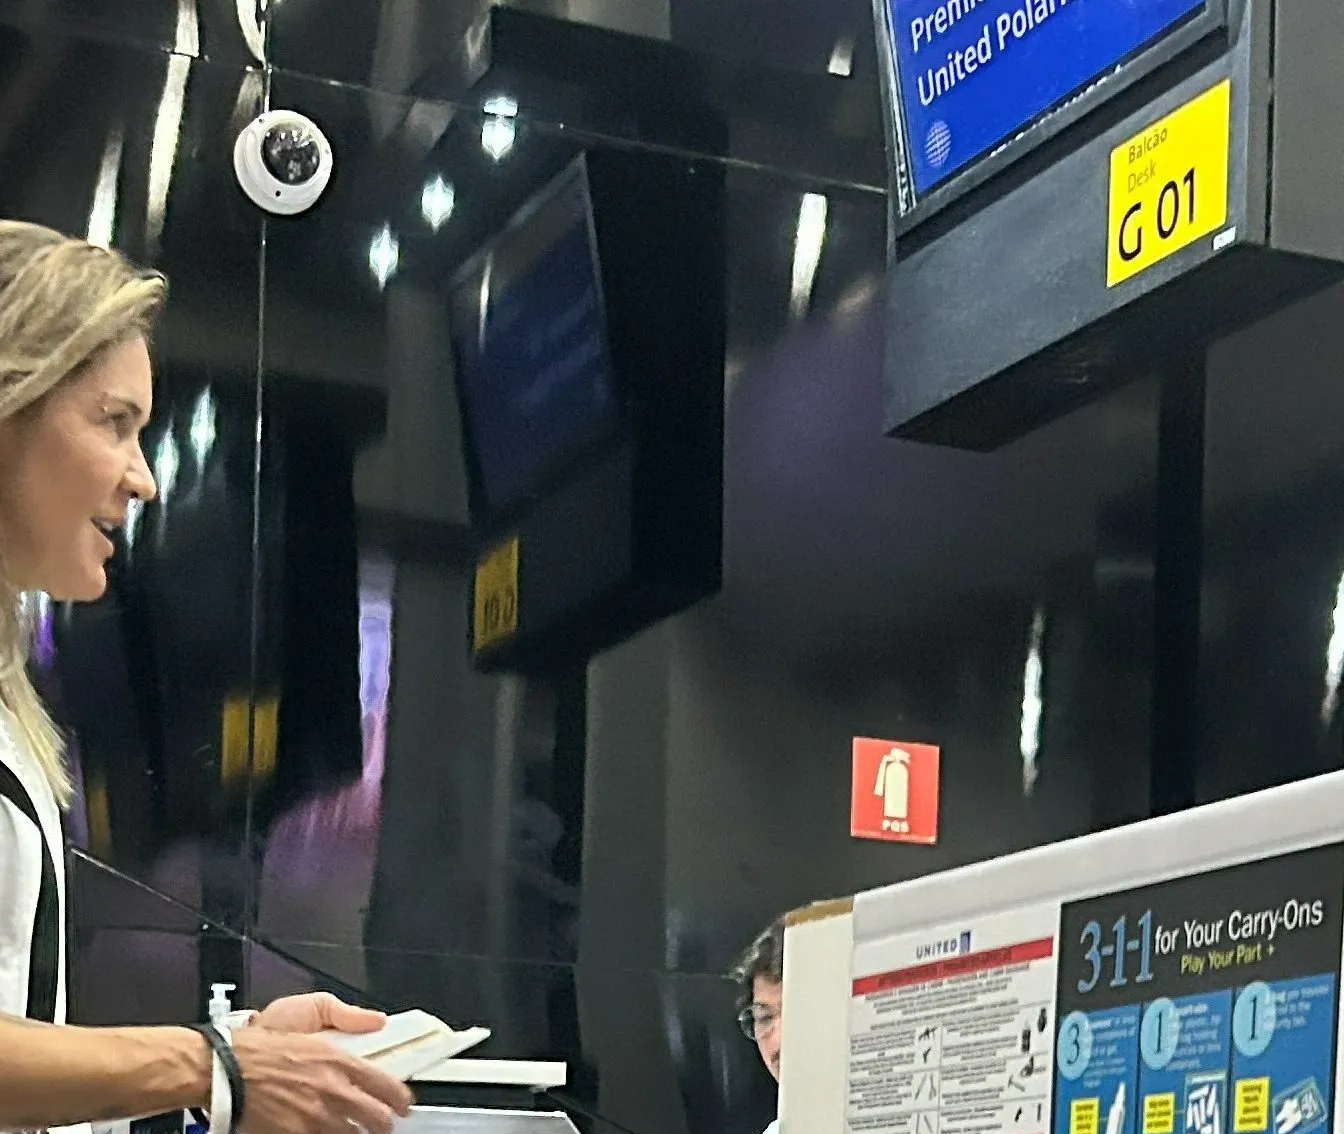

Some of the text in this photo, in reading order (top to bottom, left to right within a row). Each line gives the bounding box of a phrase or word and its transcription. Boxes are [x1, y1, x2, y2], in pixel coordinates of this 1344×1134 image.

[918, 24, 992, 106] United
[1128, 127, 1168, 165] Balcão
[1128, 158, 1157, 193] Desk
[1118, 167, 1195, 262] G 01
[916, 942, 957, 959] UNITED
[1077, 899, 1324, 994] 3-1-1 for Your Carry-Ons
[1181, 943, 1262, 976] Play Your Part
[1067, 1022, 1080, 1065] 3
